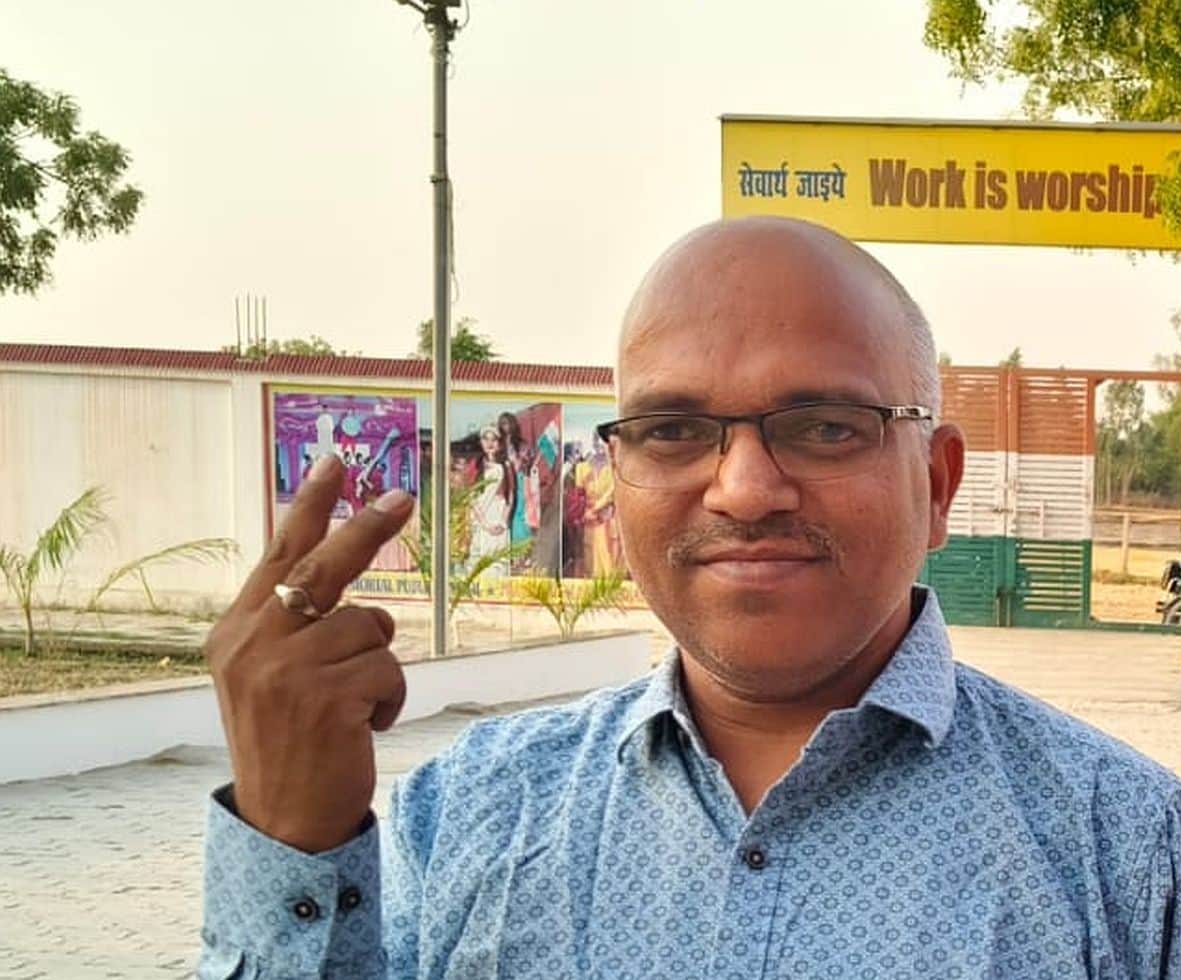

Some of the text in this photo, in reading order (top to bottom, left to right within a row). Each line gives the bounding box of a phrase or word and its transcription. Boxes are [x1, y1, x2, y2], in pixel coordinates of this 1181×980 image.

[794, 162, 847, 202] जाइये
[869, 159, 968, 209] Work
[975, 162, 1008, 210] is
